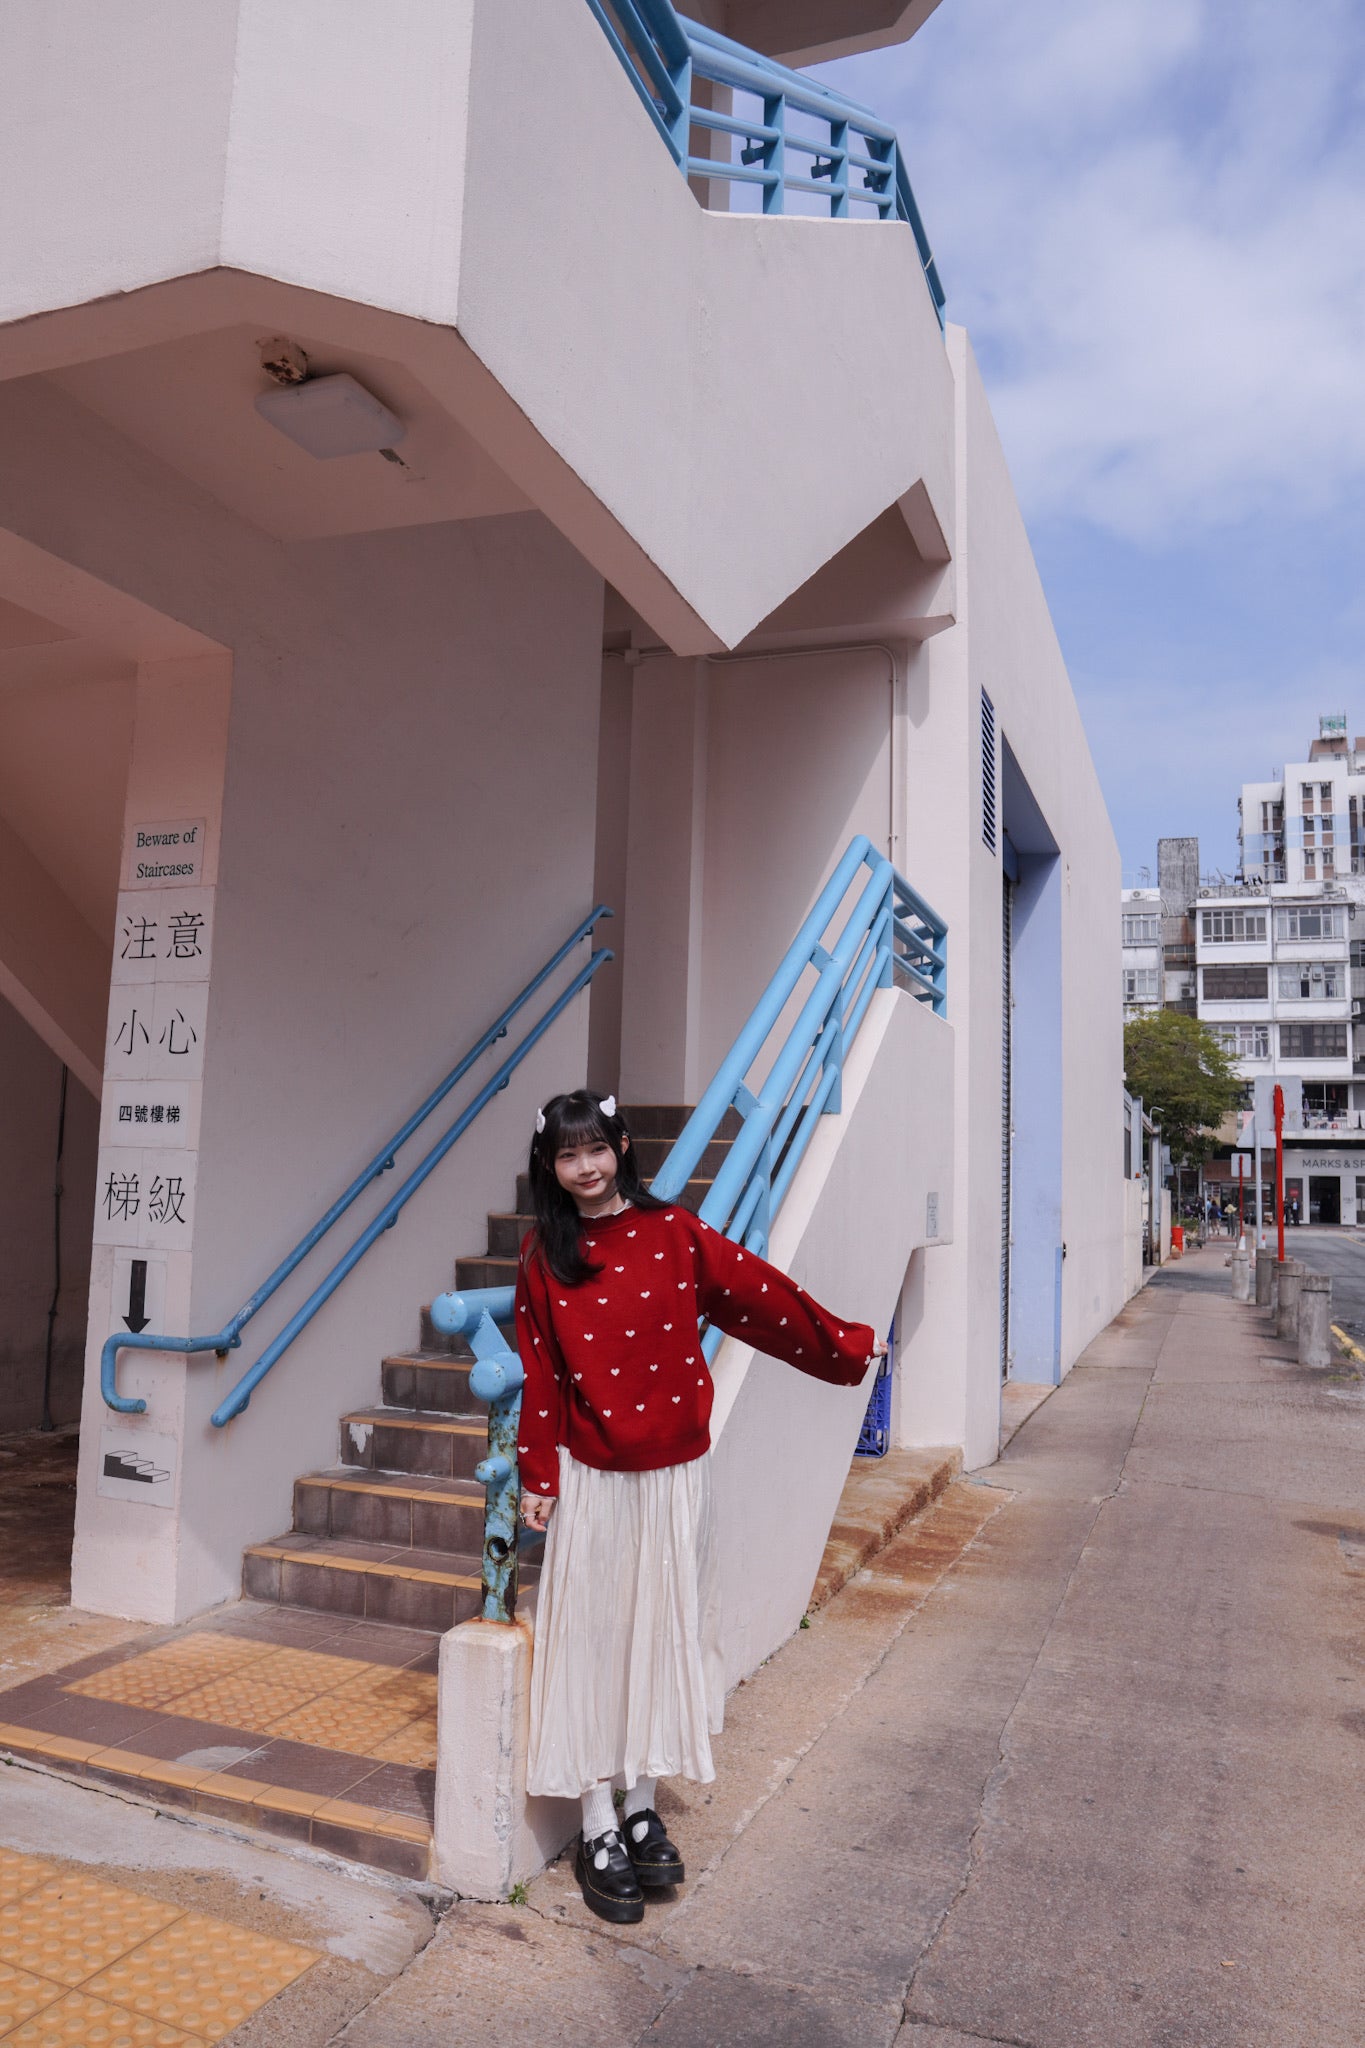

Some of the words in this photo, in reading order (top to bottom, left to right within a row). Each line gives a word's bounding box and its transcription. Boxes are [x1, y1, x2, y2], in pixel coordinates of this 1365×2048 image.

[136, 832, 180, 848] Beware
[183, 827, 198, 844] of
[136, 861, 194, 878] Staircases
[121, 910, 205, 959] 注意
[113, 1008, 197, 1055] 小心
[119, 1105, 181, 1123] 四號樓梯
[1302, 1159, 1341, 1169] MARKS
[1343, 1159, 1351, 1169] &
[103, 1171, 186, 1224] 梯級
